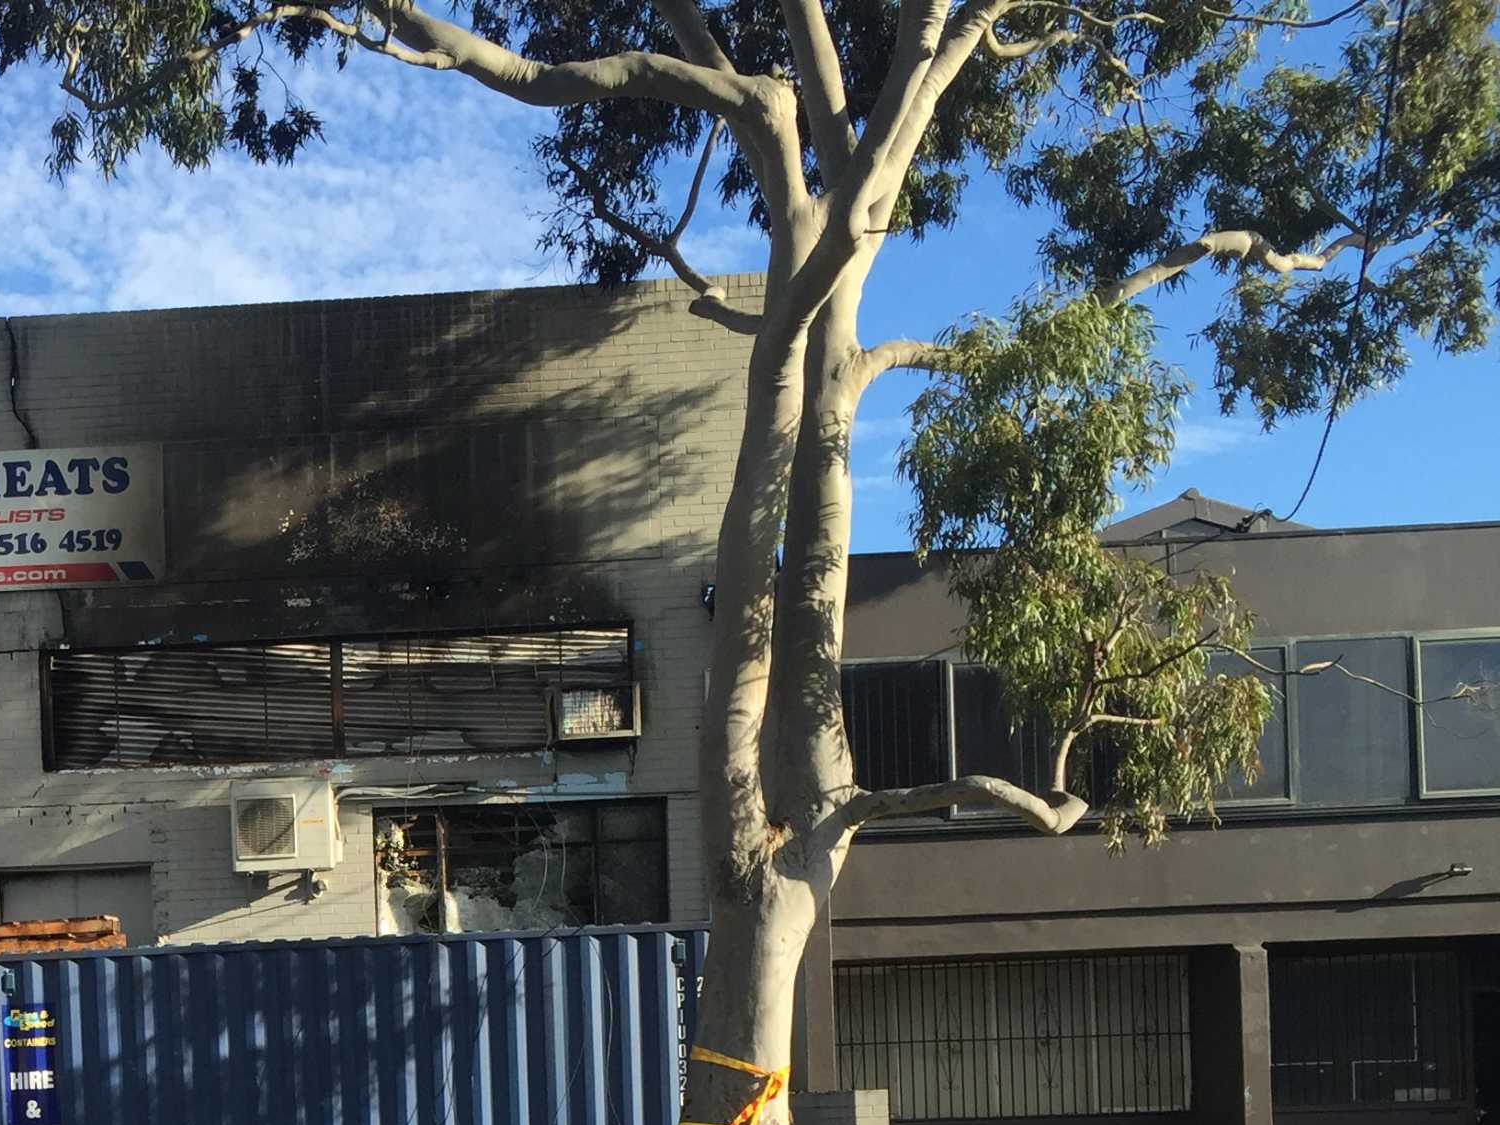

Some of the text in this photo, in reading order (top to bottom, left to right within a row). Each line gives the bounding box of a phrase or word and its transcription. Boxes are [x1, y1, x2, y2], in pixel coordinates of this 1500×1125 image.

[58, 528, 122, 553] 4519
[10, 1069, 54, 1091] HIRE
[26, 1100, 42, 1119] &
